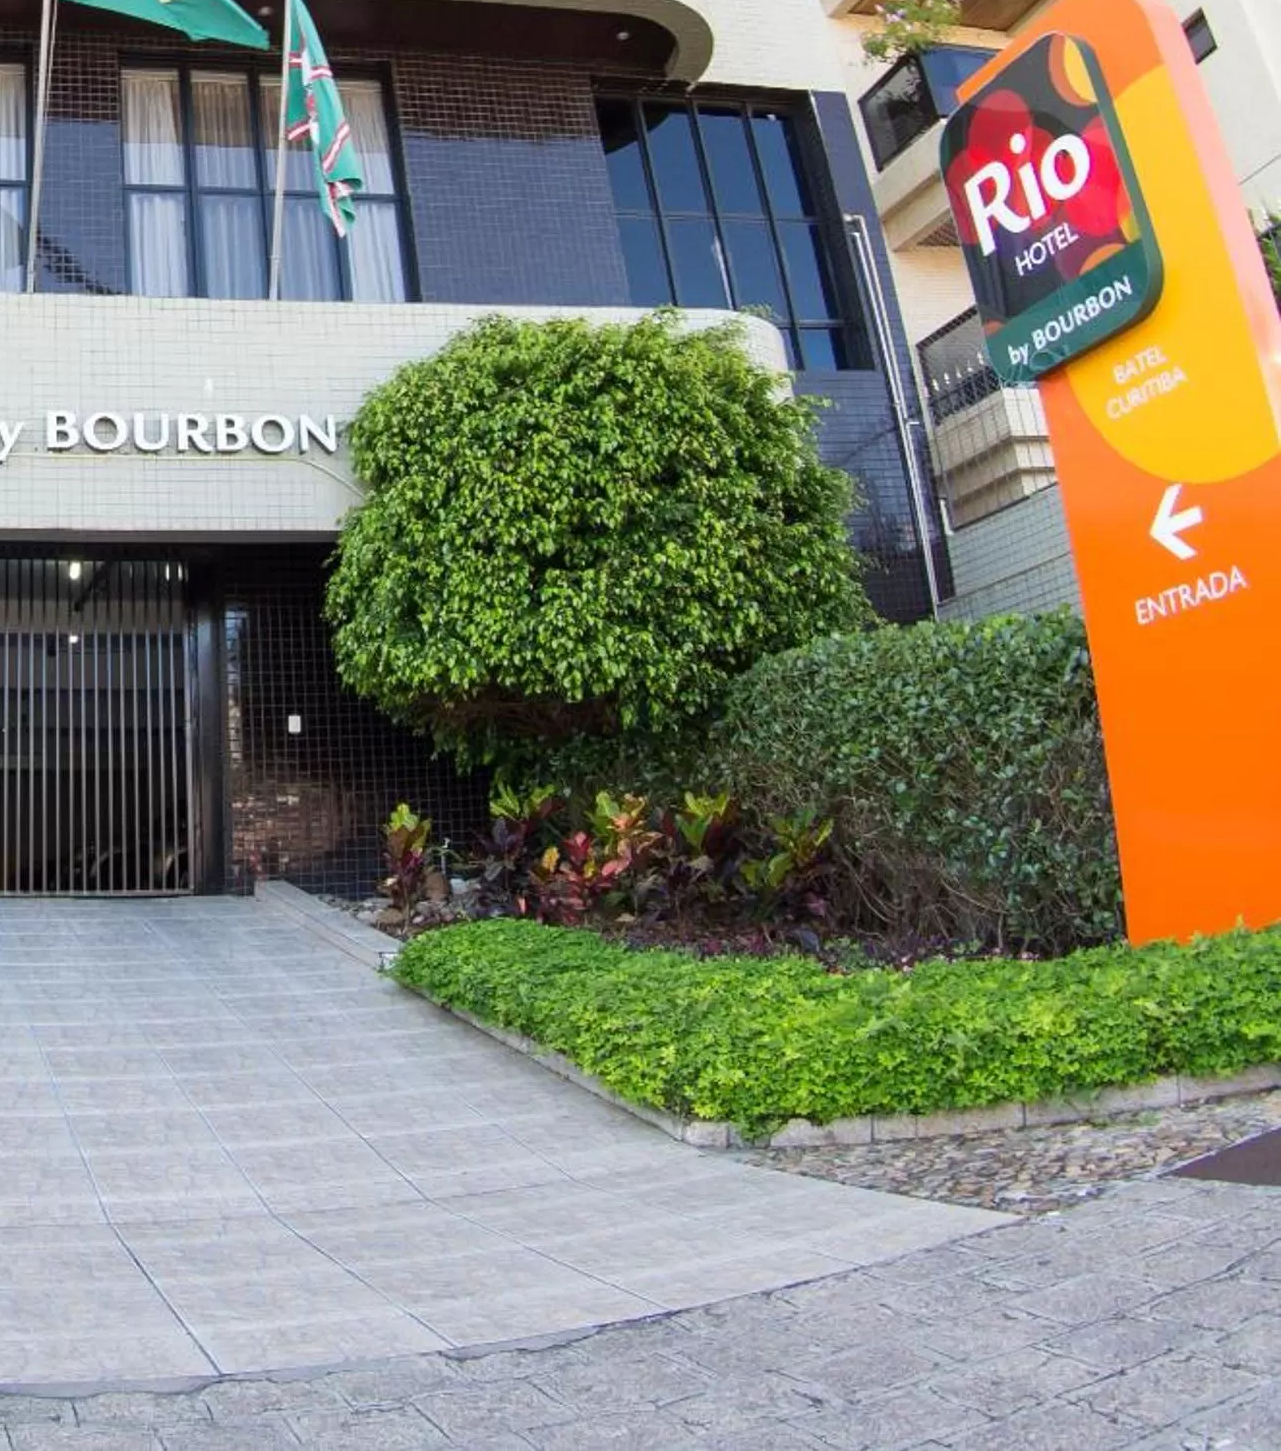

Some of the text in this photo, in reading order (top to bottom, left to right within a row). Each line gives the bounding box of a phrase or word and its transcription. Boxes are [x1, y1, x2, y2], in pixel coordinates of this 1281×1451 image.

[964, 133, 1091, 257] Rio
[1015, 222, 1079, 276] HOTEL
[1007, 275, 1133, 366] by BOURBON
[1113, 345, 1167, 384] BATEL
[1105, 365, 1188, 421] CURITIBA
[46, 410, 338, 454] BOURBON
[1135, 565, 1248, 625] ENTRADA
